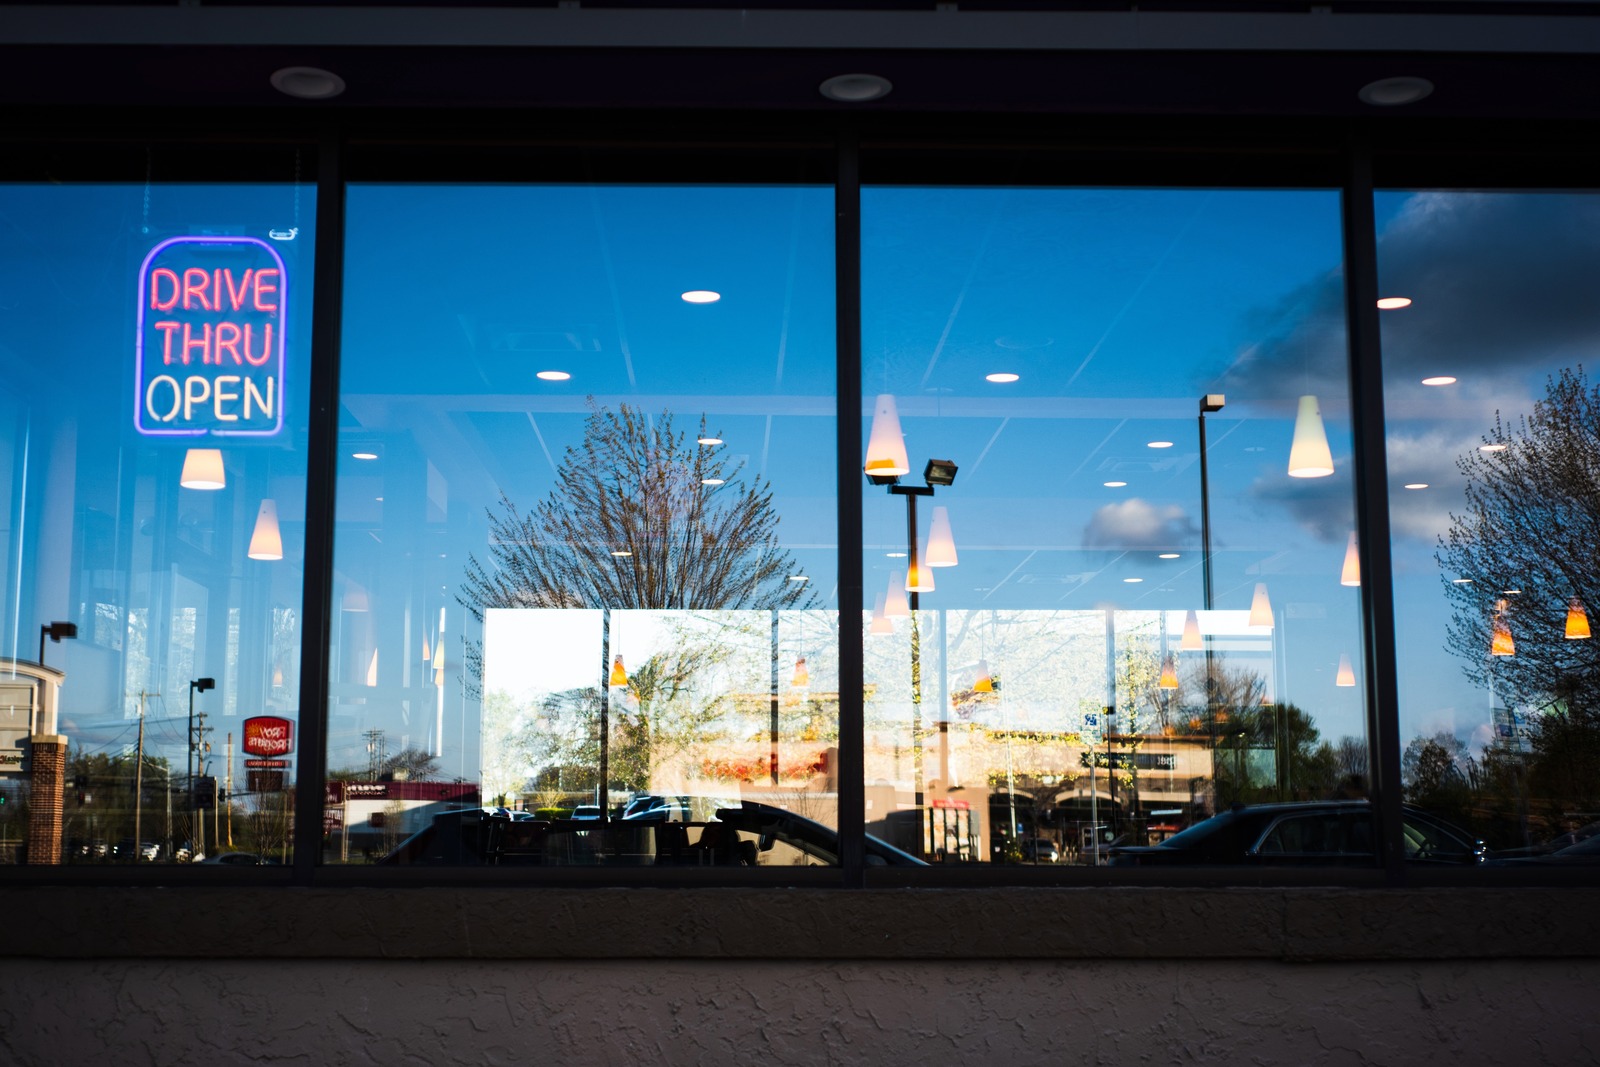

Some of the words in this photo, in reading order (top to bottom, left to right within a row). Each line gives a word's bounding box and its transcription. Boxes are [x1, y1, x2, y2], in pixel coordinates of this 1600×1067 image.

[150, 267, 280, 312] DRIVE
[154, 321, 273, 366] THRU
[146, 374, 274, 422] OPEN
